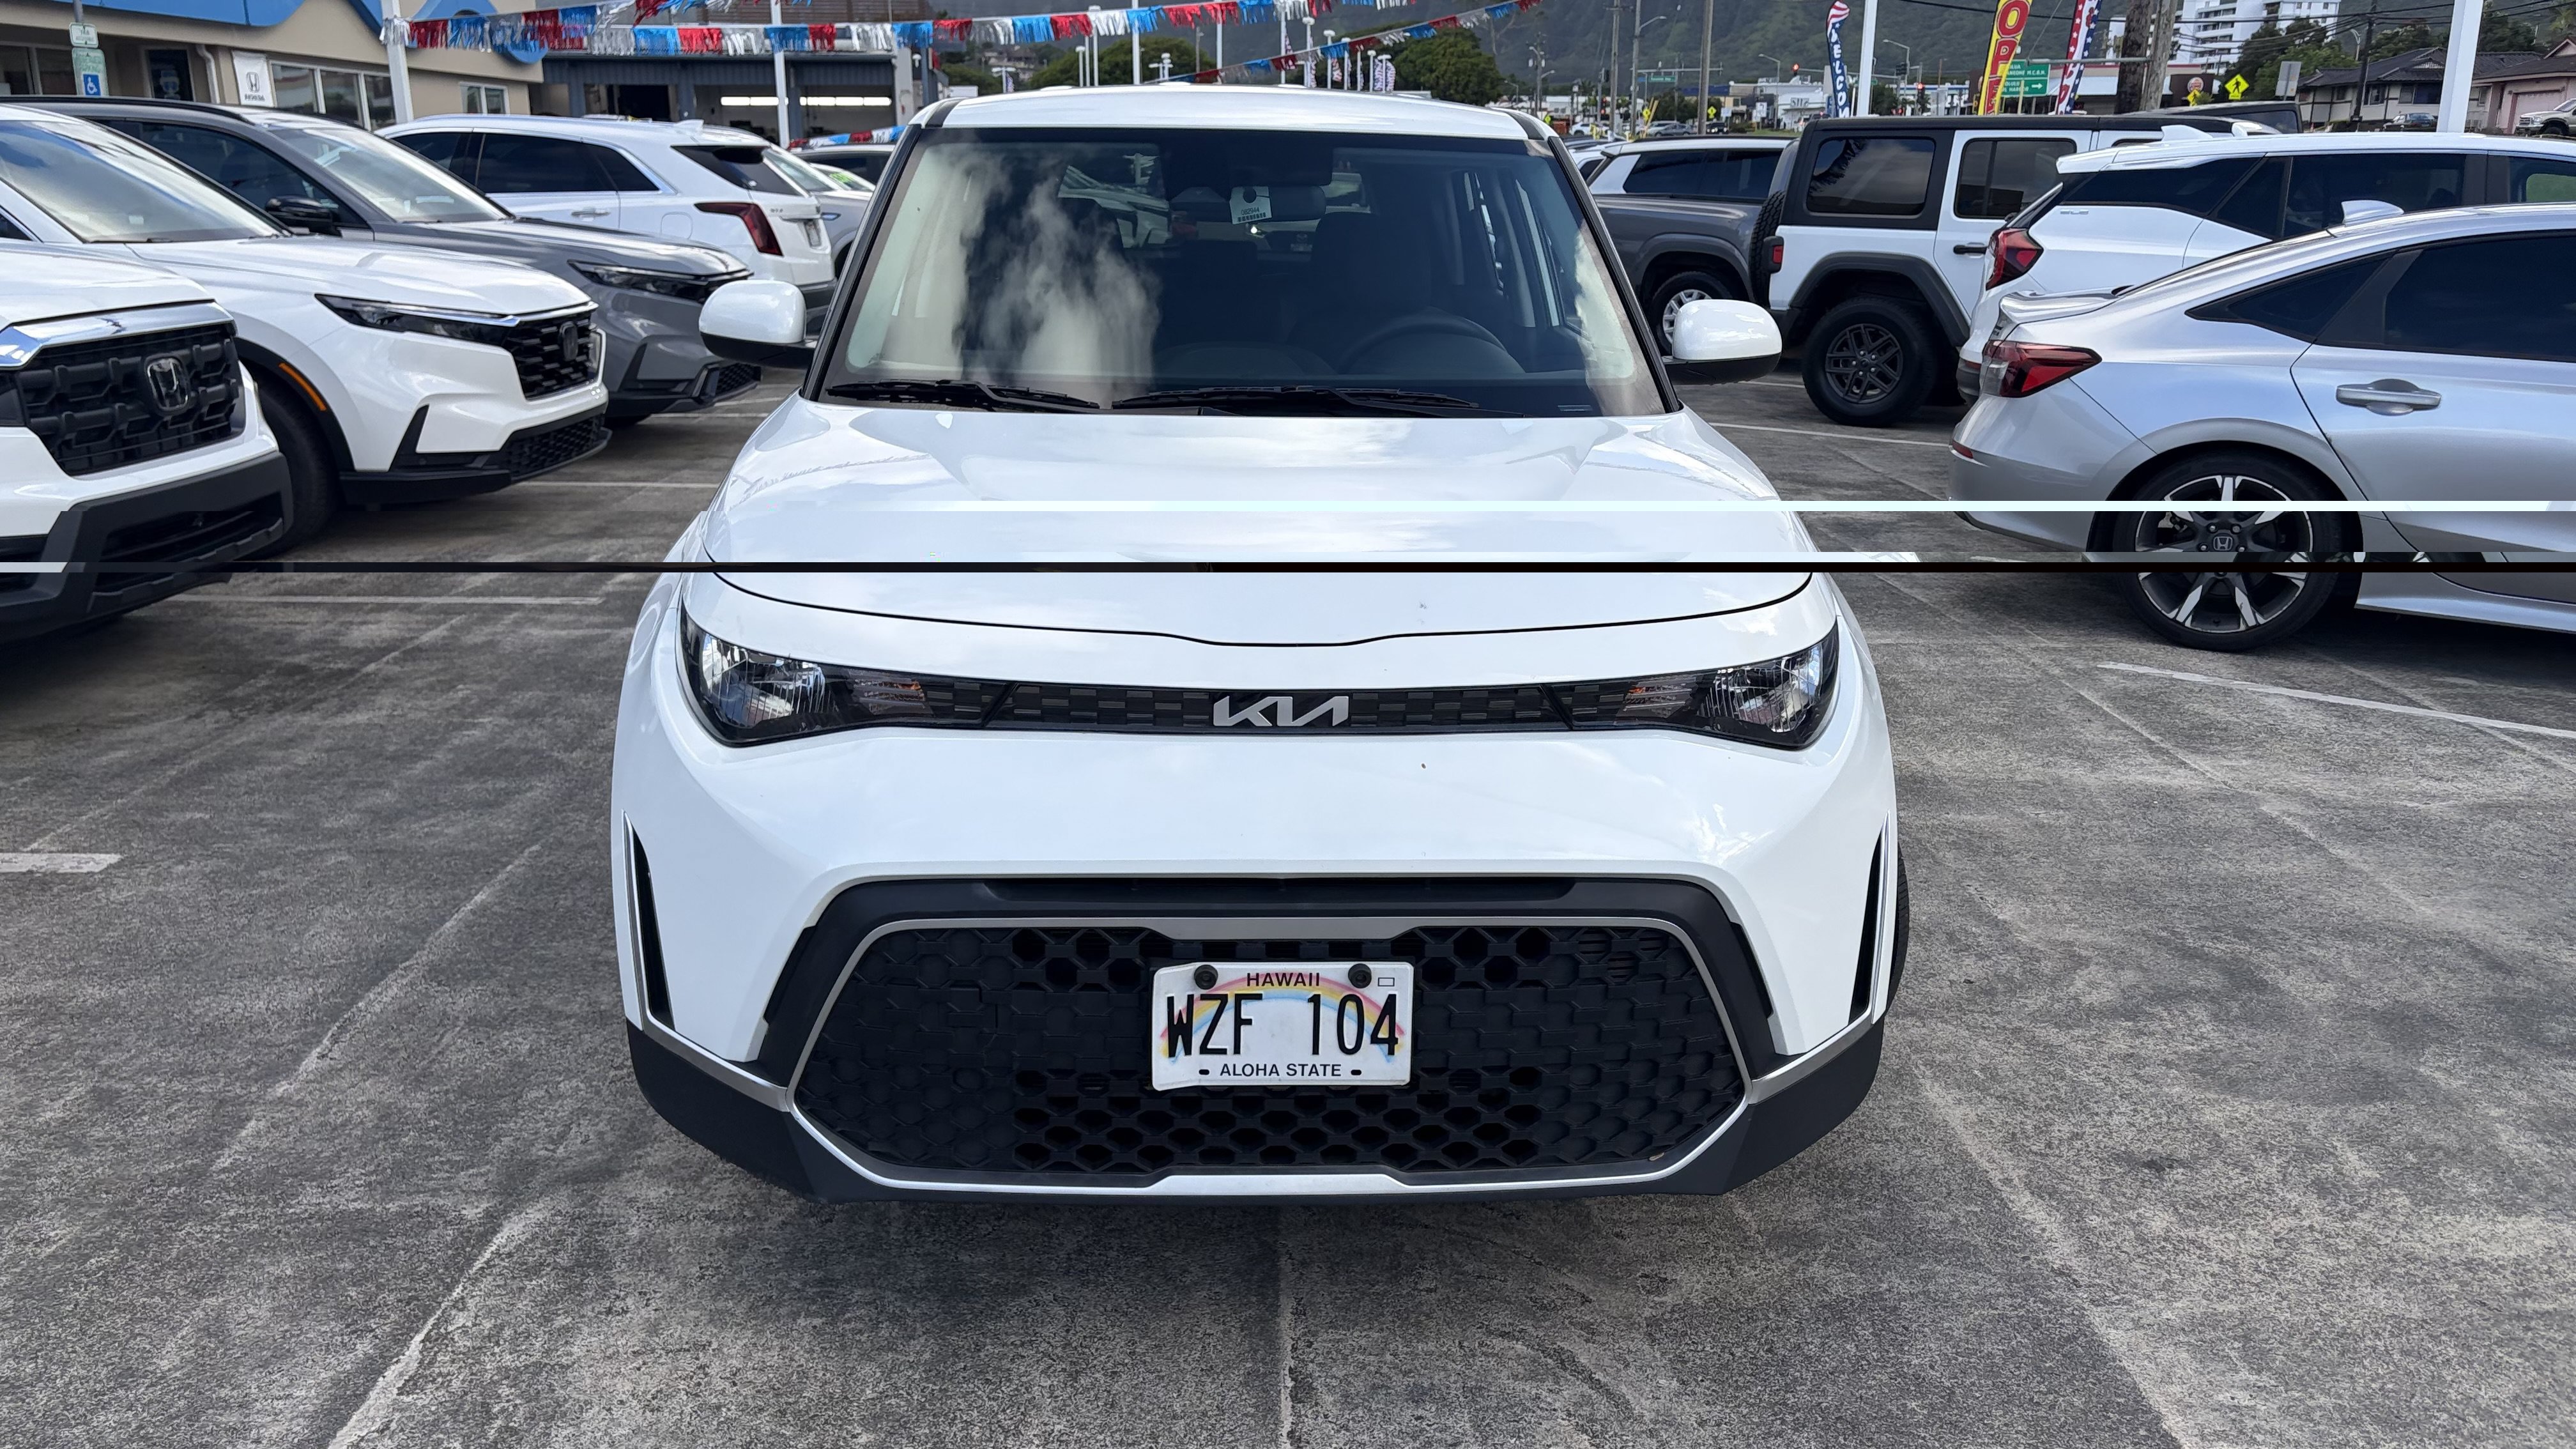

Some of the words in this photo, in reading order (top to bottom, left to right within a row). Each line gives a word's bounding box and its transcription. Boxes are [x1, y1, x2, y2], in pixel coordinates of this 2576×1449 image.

[1213, 696, 1349, 726] KIA
[1246, 972, 1320, 987] HAWAII
[1167, 993, 1263, 1058] WZF
[1307, 993, 1399, 1056] 104
[1220, 1064, 1280, 1077] ALOHA
[1286, 1064, 1342, 1077] STATE
